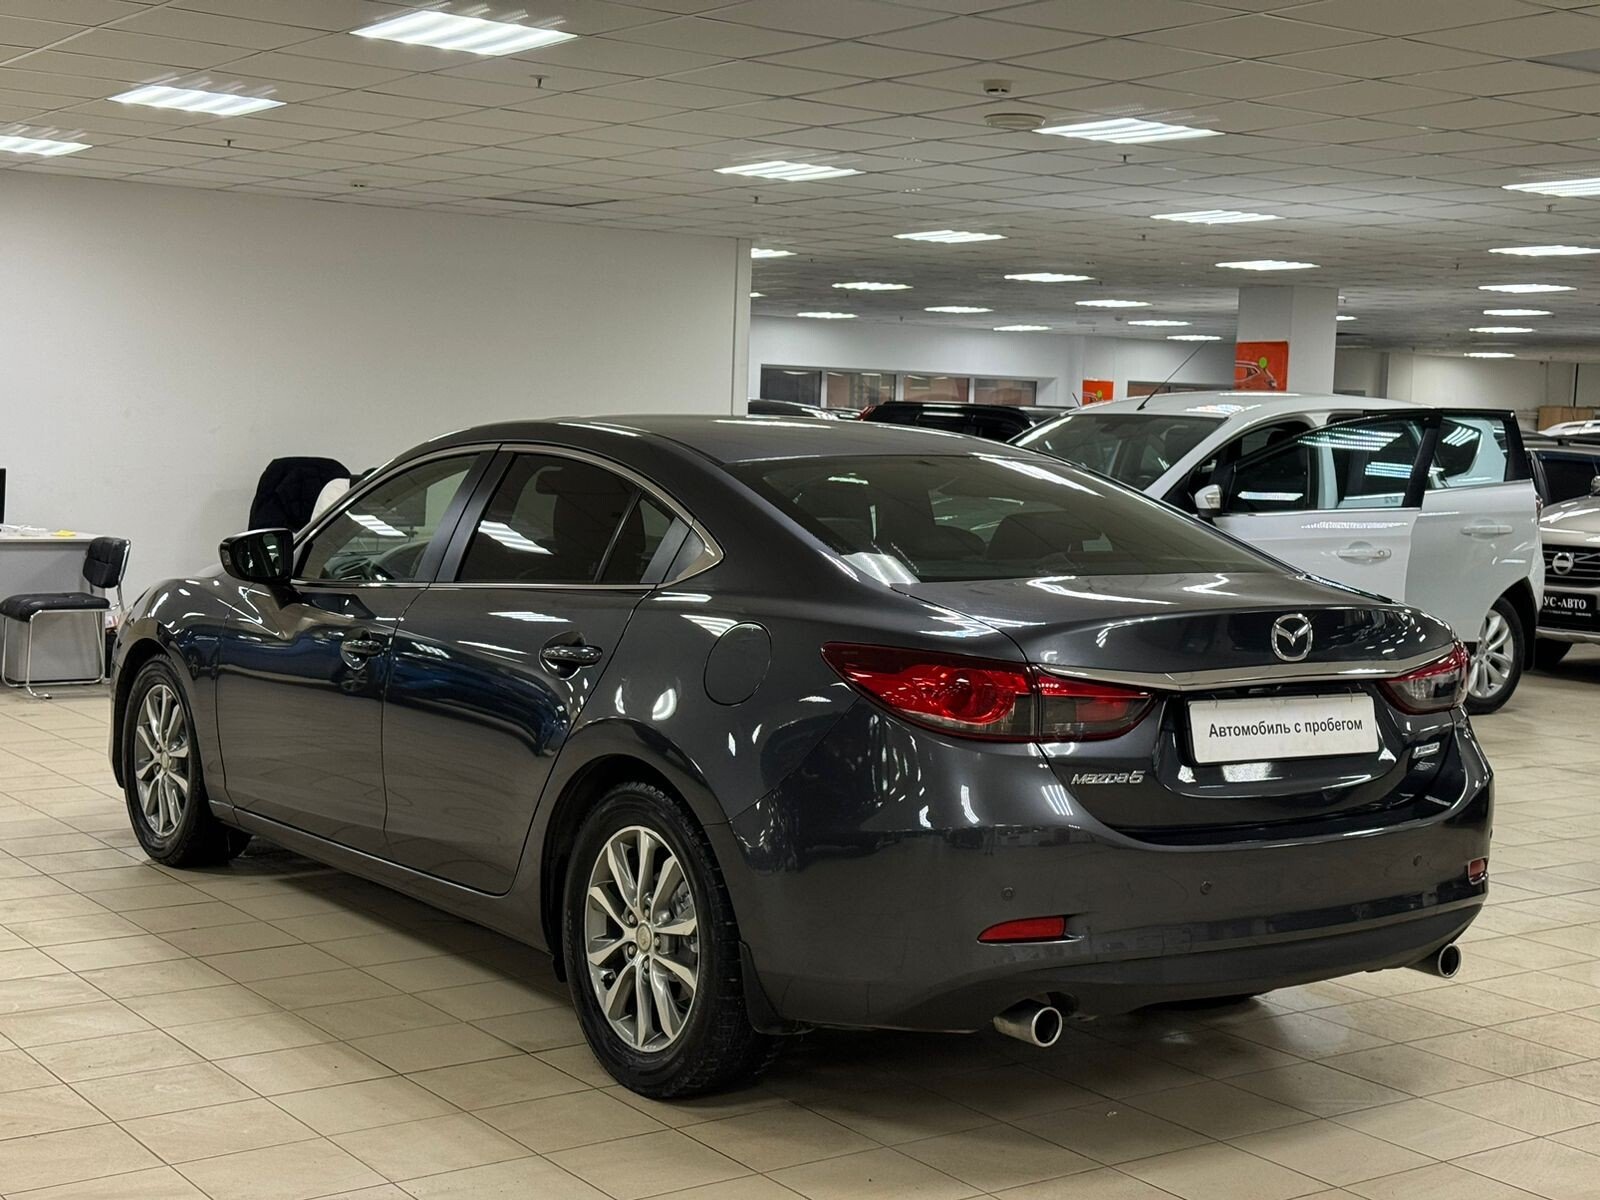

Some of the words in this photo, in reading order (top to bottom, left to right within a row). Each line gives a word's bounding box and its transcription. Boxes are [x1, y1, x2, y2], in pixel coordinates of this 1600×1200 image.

[1208, 720, 1291, 738] Автомобиль
[1294, 721, 1302, 734] с
[1304, 717, 1363, 736] пробегом
